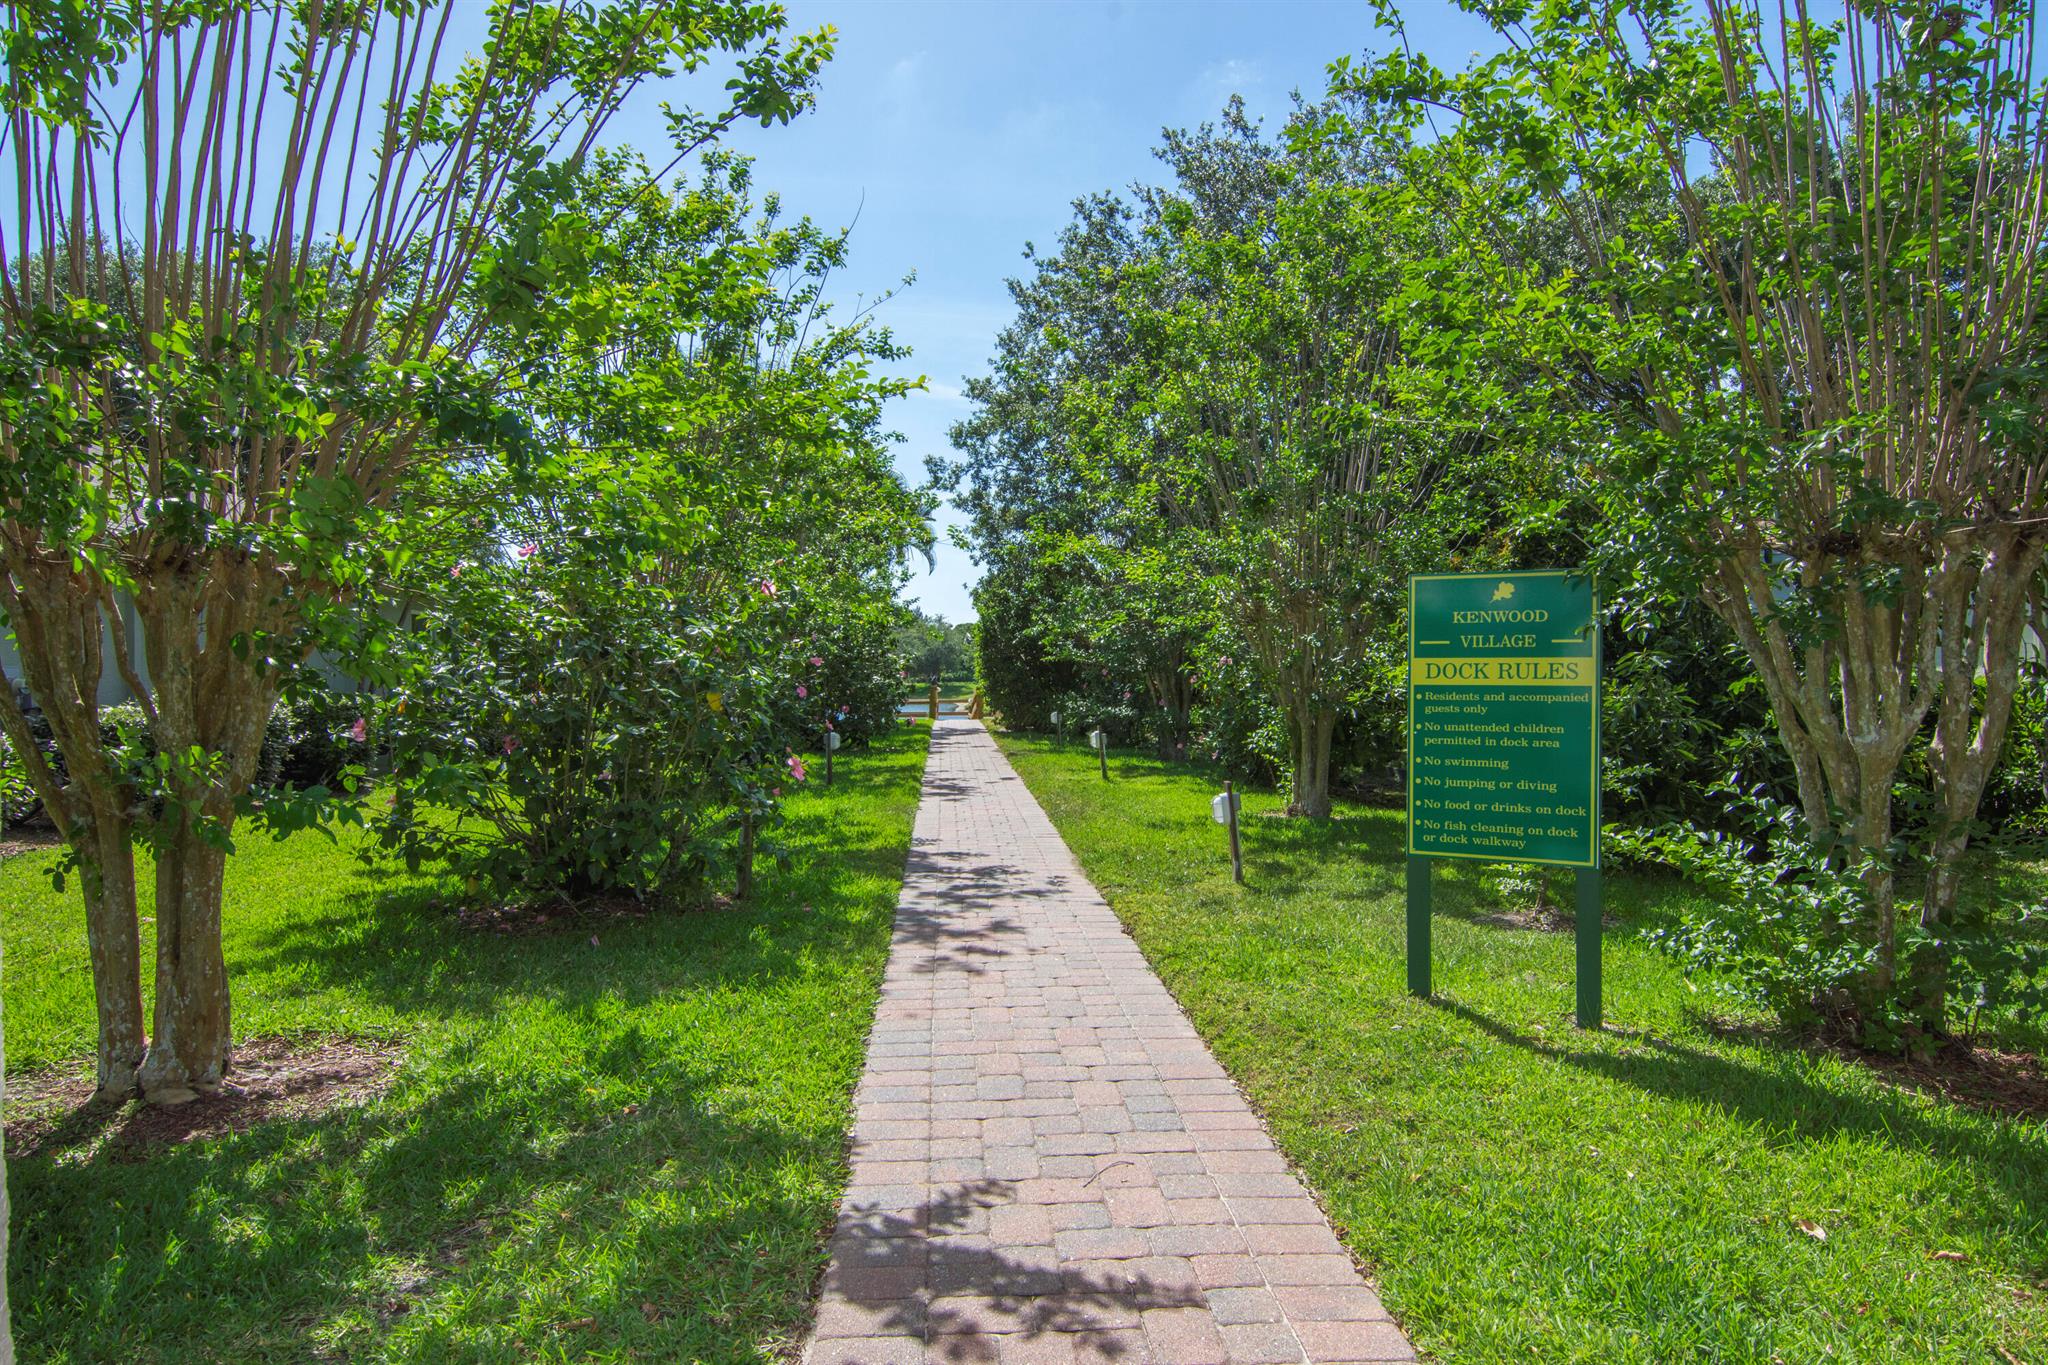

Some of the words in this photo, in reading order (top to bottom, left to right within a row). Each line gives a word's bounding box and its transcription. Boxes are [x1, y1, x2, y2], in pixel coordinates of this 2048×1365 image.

[1453, 610, 1548, 624] KENWOOD
[1460, 635, 1536, 648] VILLAGE
[1425, 663, 1489, 679] DOCK
[1498, 662, 1579, 680] RULES
[1425, 692, 1480, 701] Residents
[1484, 693, 1504, 701] and
[1509, 693, 1588, 704] accompanied
[1425, 705, 1460, 714] guests
[1463, 705, 1488, 715] only
[1424, 722, 1440, 731] No
[1444, 723, 1509, 732] unattended
[1514, 725, 1564, 733] children
[1424, 737, 1480, 746] permitted
[1485, 737, 1496, 746] in
[1500, 738, 1528, 747] dock
[1532, 740, 1560, 748] area
[1424, 756, 1440, 765] No
[1445, 757, 1509, 770] swimming
[1424, 777, 1440, 785] No
[1444, 777, 1495, 790] jumping
[1499, 781, 1513, 789] or
[1517, 779, 1557, 793] diving
[1424, 799, 1440, 808] No
[1445, 801, 1470, 810] food
[1474, 803, 1487, 811] or
[1491, 803, 1531, 813] drinks
[1536, 806, 1551, 814] on
[1555, 805, 1586, 816] dock
[1424, 820, 1440, 829] No
[1444, 821, 1466, 831] fish
[1471, 823, 1524, 836] cleaning
[1528, 827, 1543, 835] on
[1547, 827, 1578, 837] dock
[1423, 834, 1436, 842] or
[1440, 834, 1468, 844] dock
[1472, 836, 1526, 849] walkway
